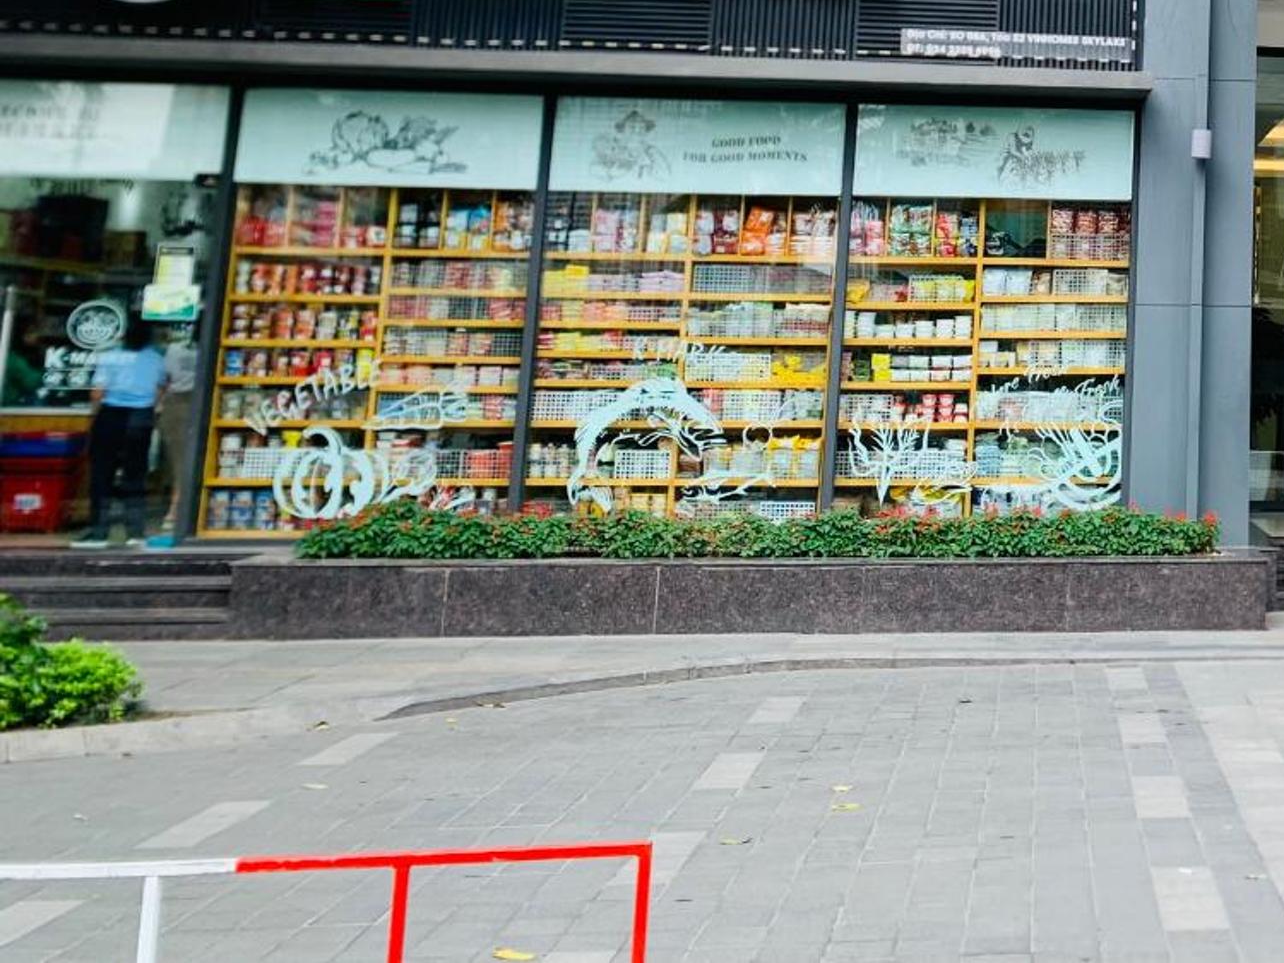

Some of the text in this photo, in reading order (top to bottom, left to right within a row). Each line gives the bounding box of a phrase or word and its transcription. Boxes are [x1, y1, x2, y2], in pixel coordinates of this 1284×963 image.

[711, 135, 782, 149] GOOD FOOD
[747, 149, 808, 162] MOMENTS
